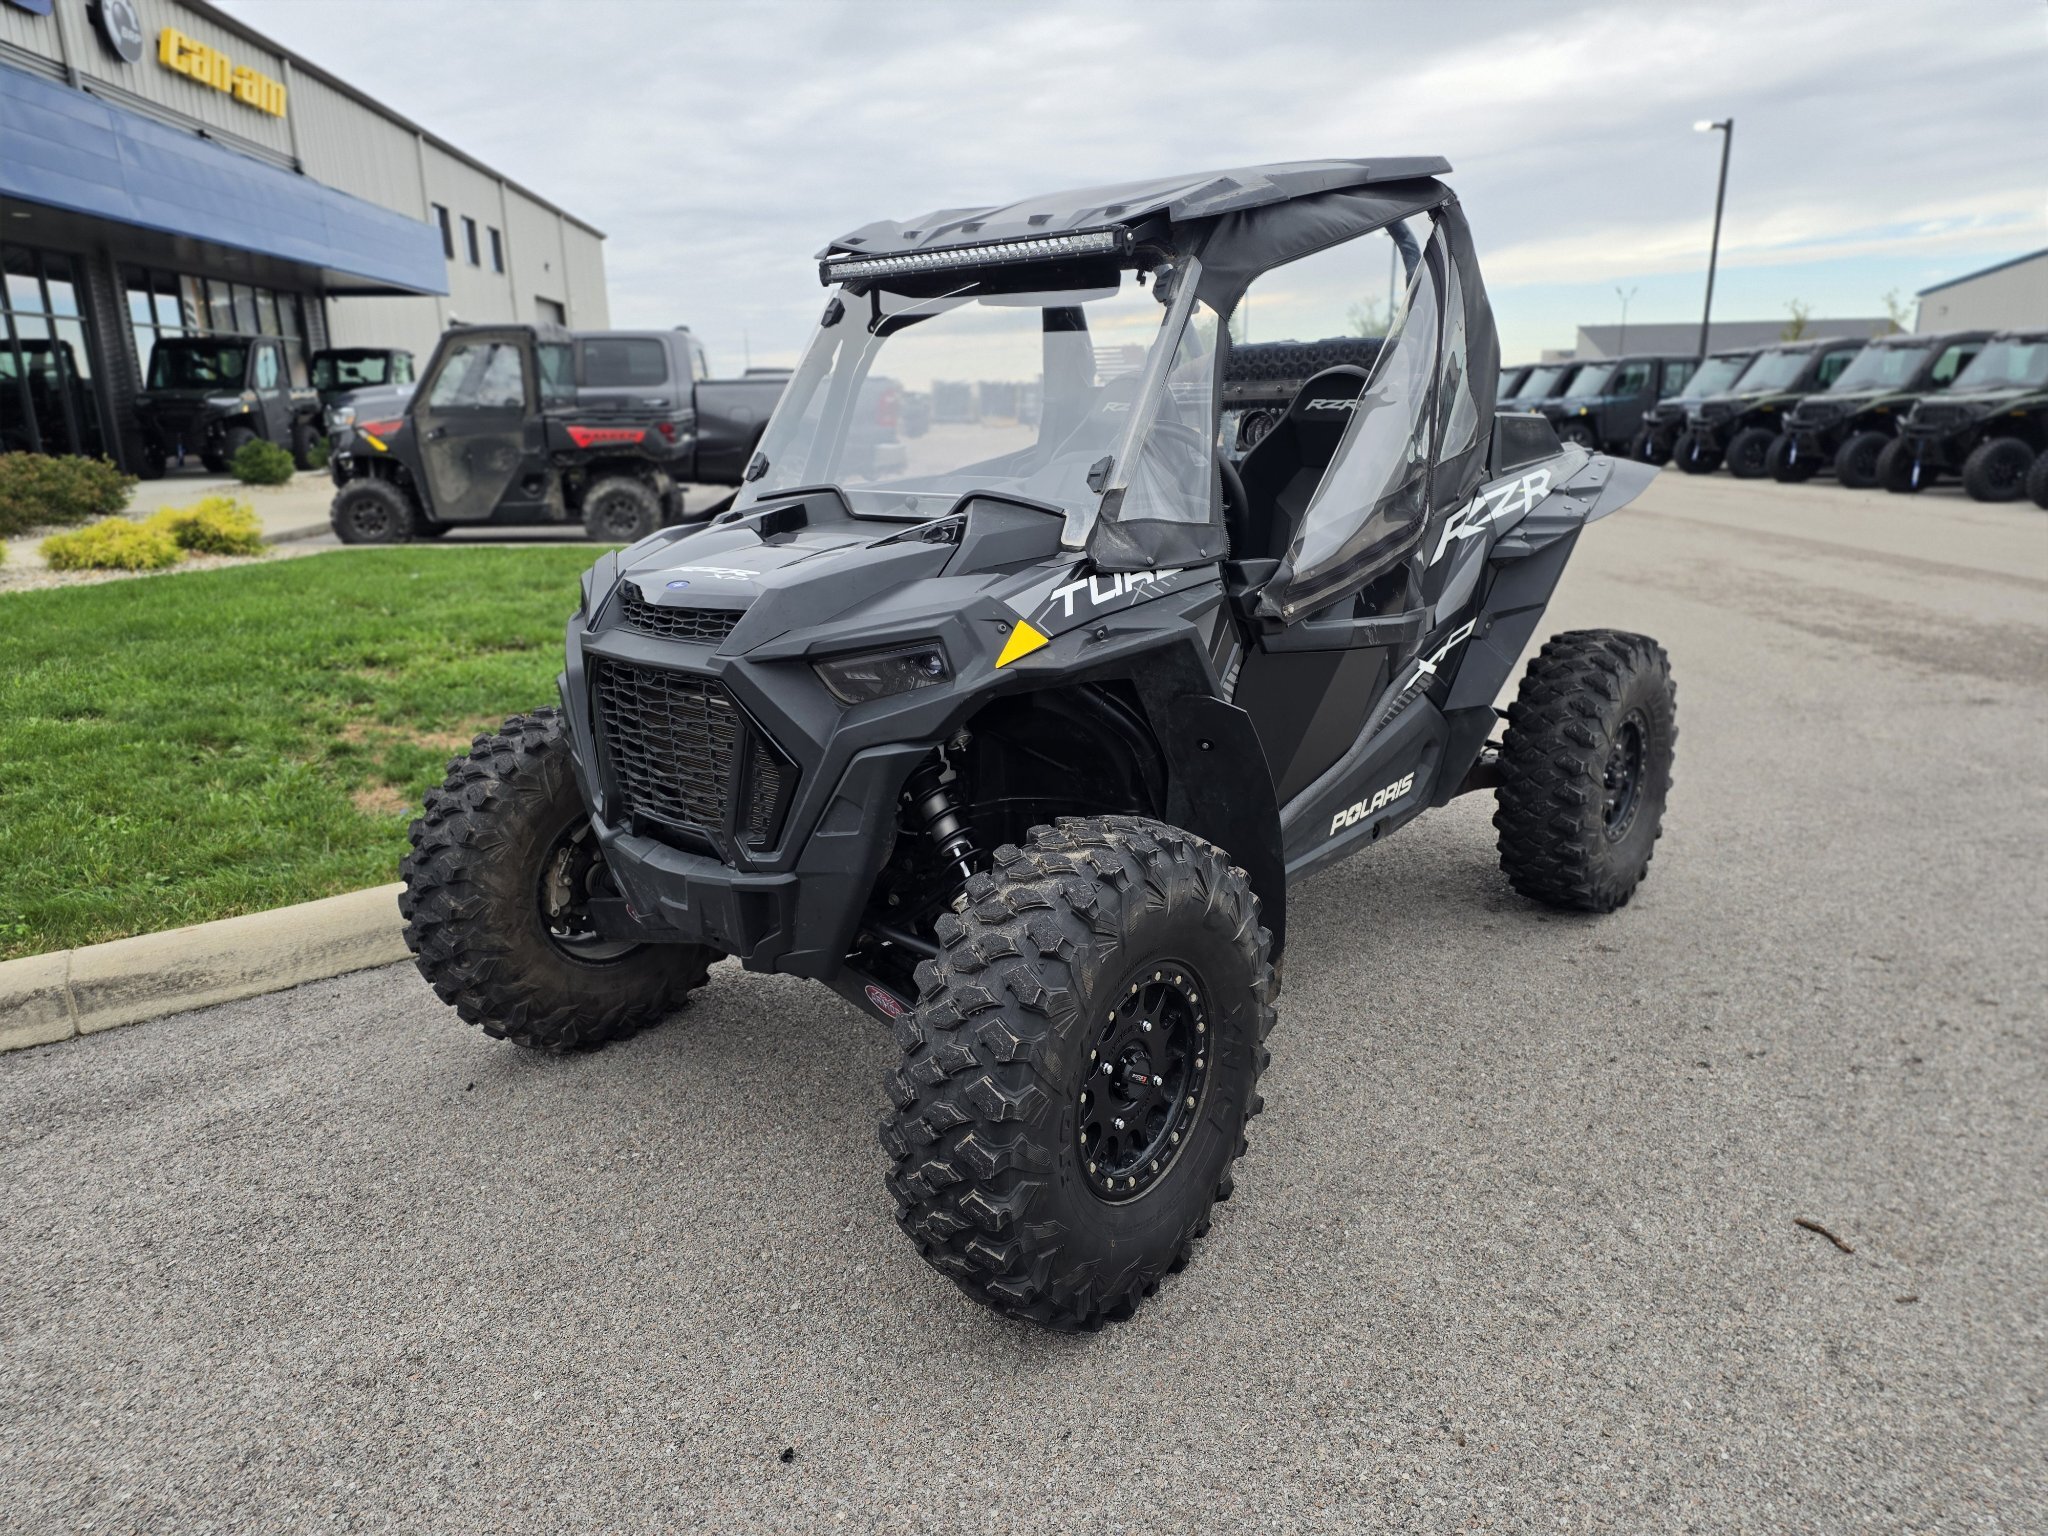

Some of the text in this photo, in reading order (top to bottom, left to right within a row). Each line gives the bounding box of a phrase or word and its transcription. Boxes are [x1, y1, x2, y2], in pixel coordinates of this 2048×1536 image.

[121, 26, 141, 43] BRP
[1101, 401, 1132, 413] RZ
[1305, 398, 1364, 411] RZR
[1429, 468, 1552, 567] RZR
[1403, 616, 1478, 691] XP
[1329, 771, 1415, 837] POLARIS
